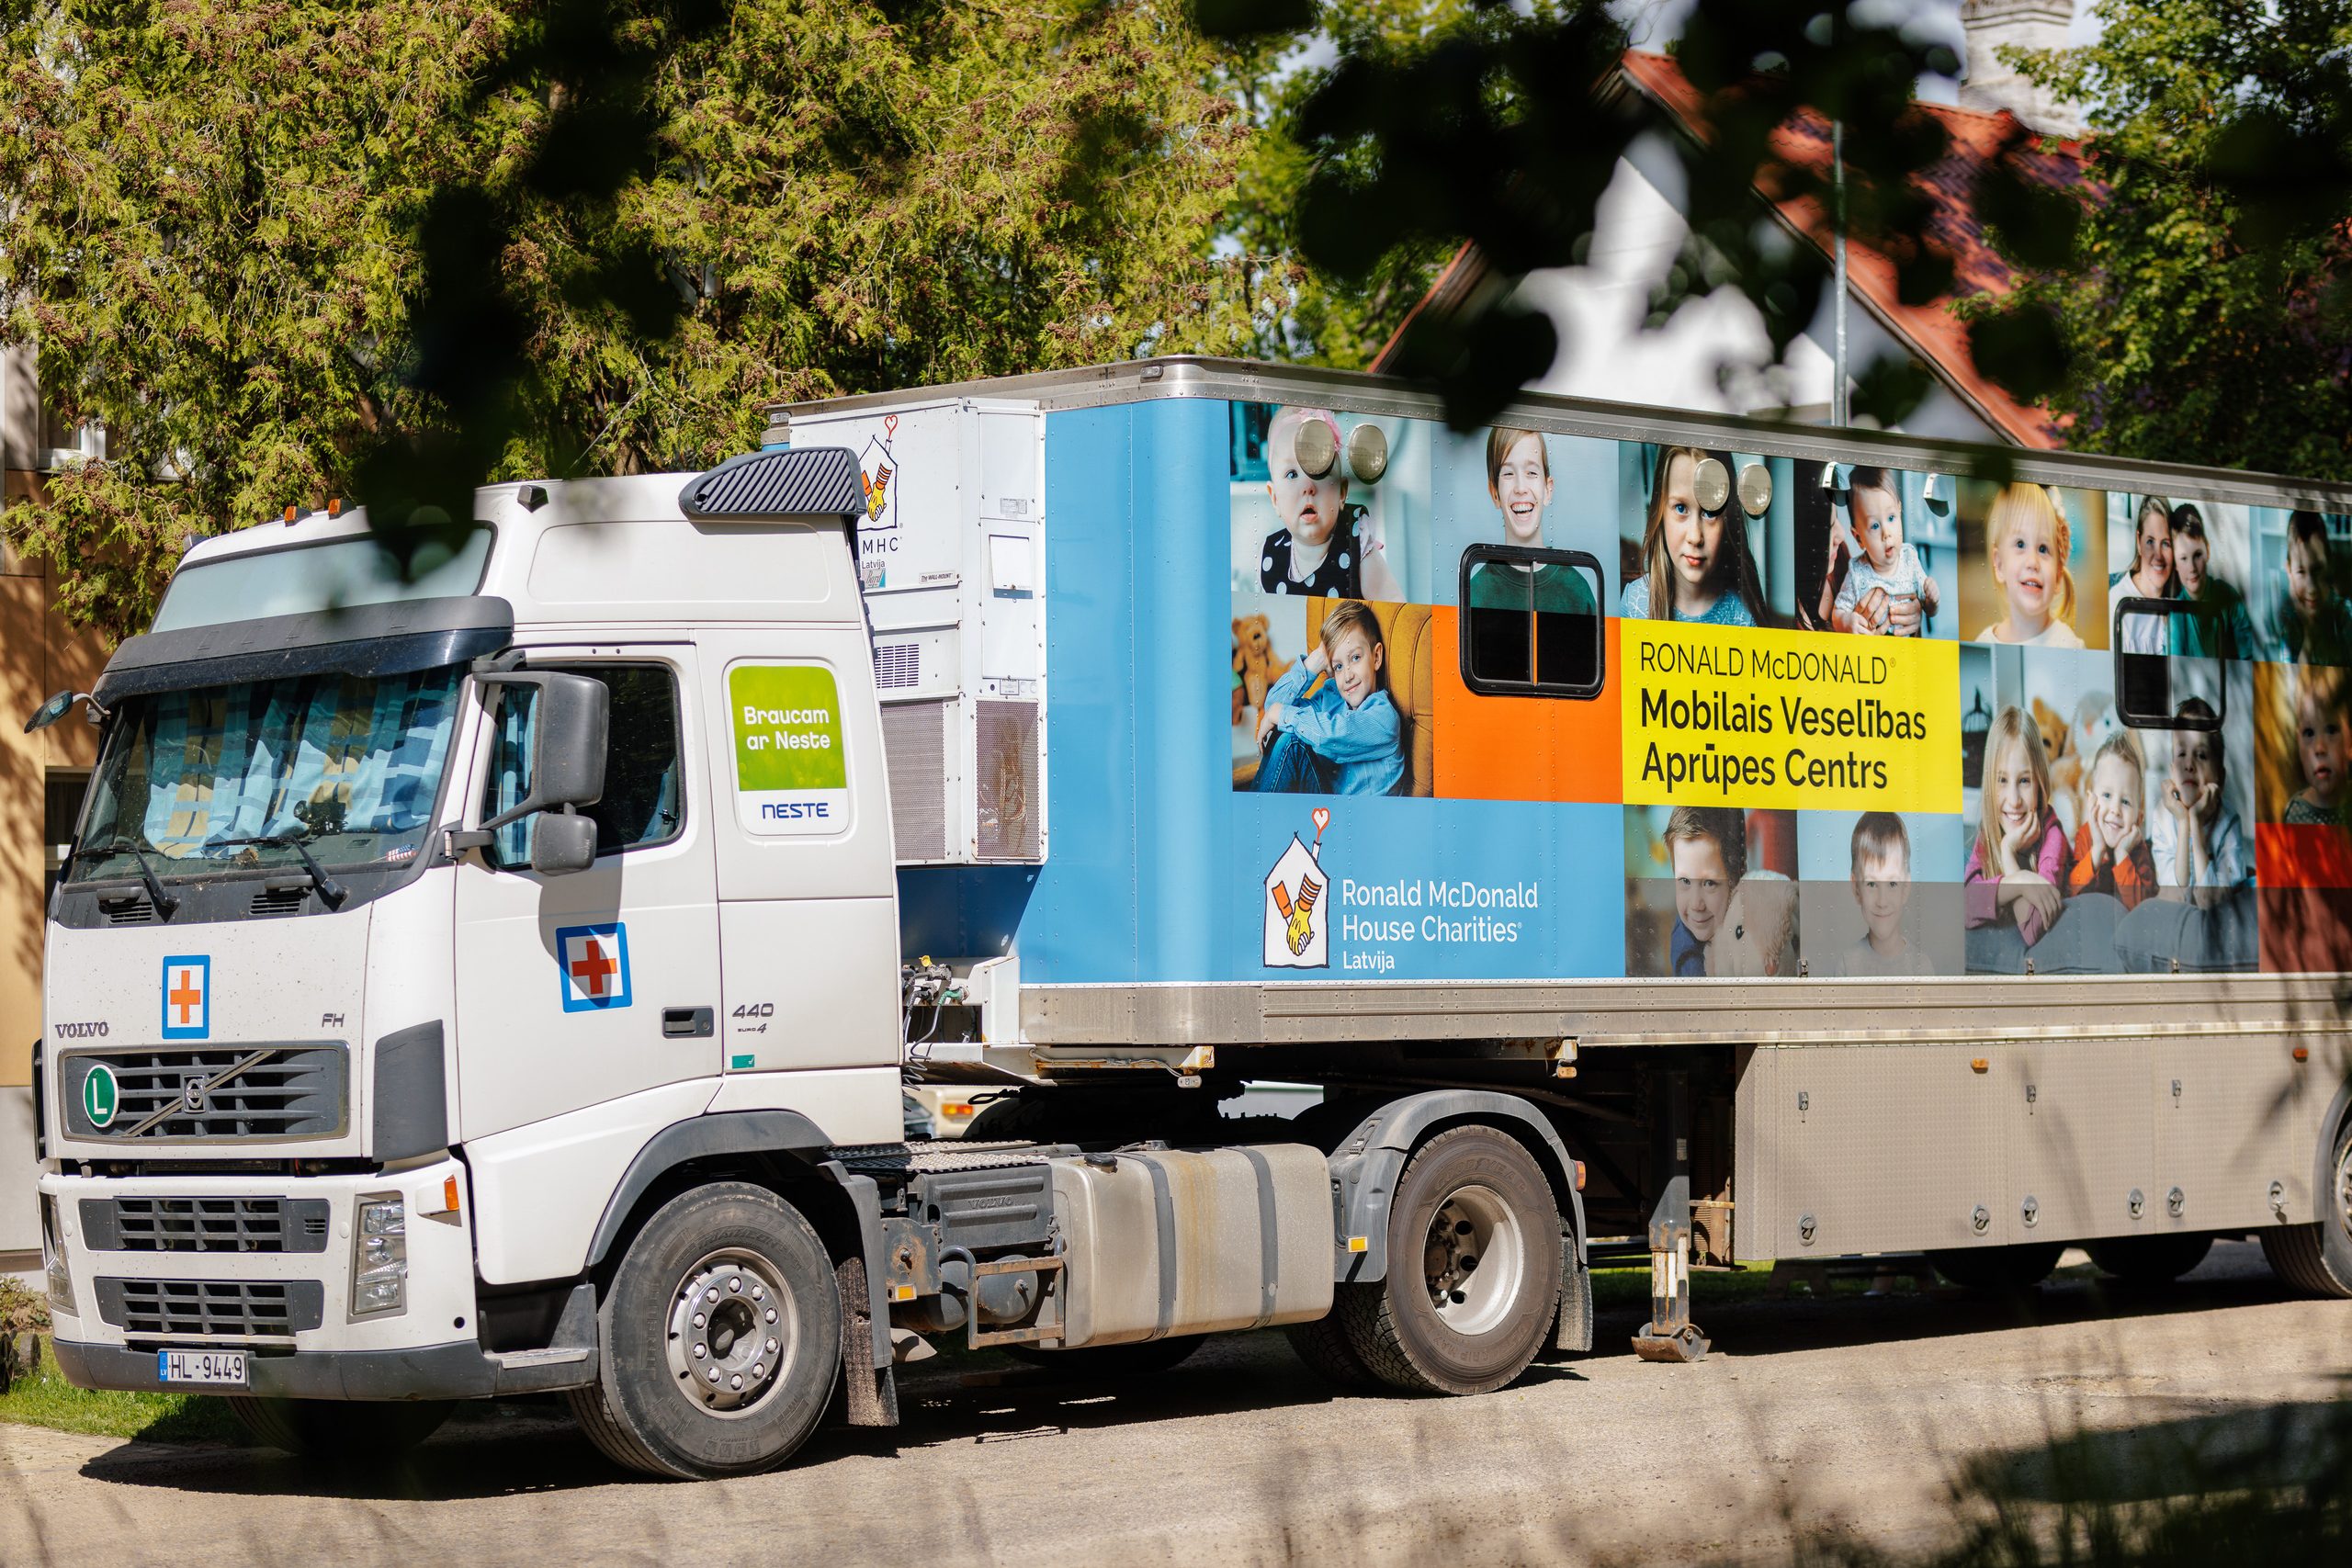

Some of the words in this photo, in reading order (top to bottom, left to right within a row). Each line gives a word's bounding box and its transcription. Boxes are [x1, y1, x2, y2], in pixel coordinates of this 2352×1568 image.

[863, 536, 899, 554] MHC
[861, 559, 886, 570] Latvija
[1640, 641, 1744, 677] RONALD
[744, 705, 830, 725] Braucam
[1641, 688, 1772, 734] Mobilais
[1781, 695, 1927, 740] Veselības
[746, 734, 769, 750] ar
[776, 730, 831, 750] Neste
[1642, 741, 1775, 795] Aprūpes
[1785, 748, 1888, 790] Centrs
[762, 803, 829, 819] NESTE
[1342, 879, 1421, 907] Ronald
[1429, 881, 1539, 908] McDonald
[1342, 915, 1415, 942] House
[1342, 950, 1395, 974] Latvija
[322, 1012, 345, 1028] FH
[731, 1002, 775, 1019] 440
[55, 1021, 109, 1039] VOLVO
[92, 1077, 108, 1114] L
[967, 1196, 1013, 1210] VOLVO
[171, 1354, 242, 1380] HL-9449
